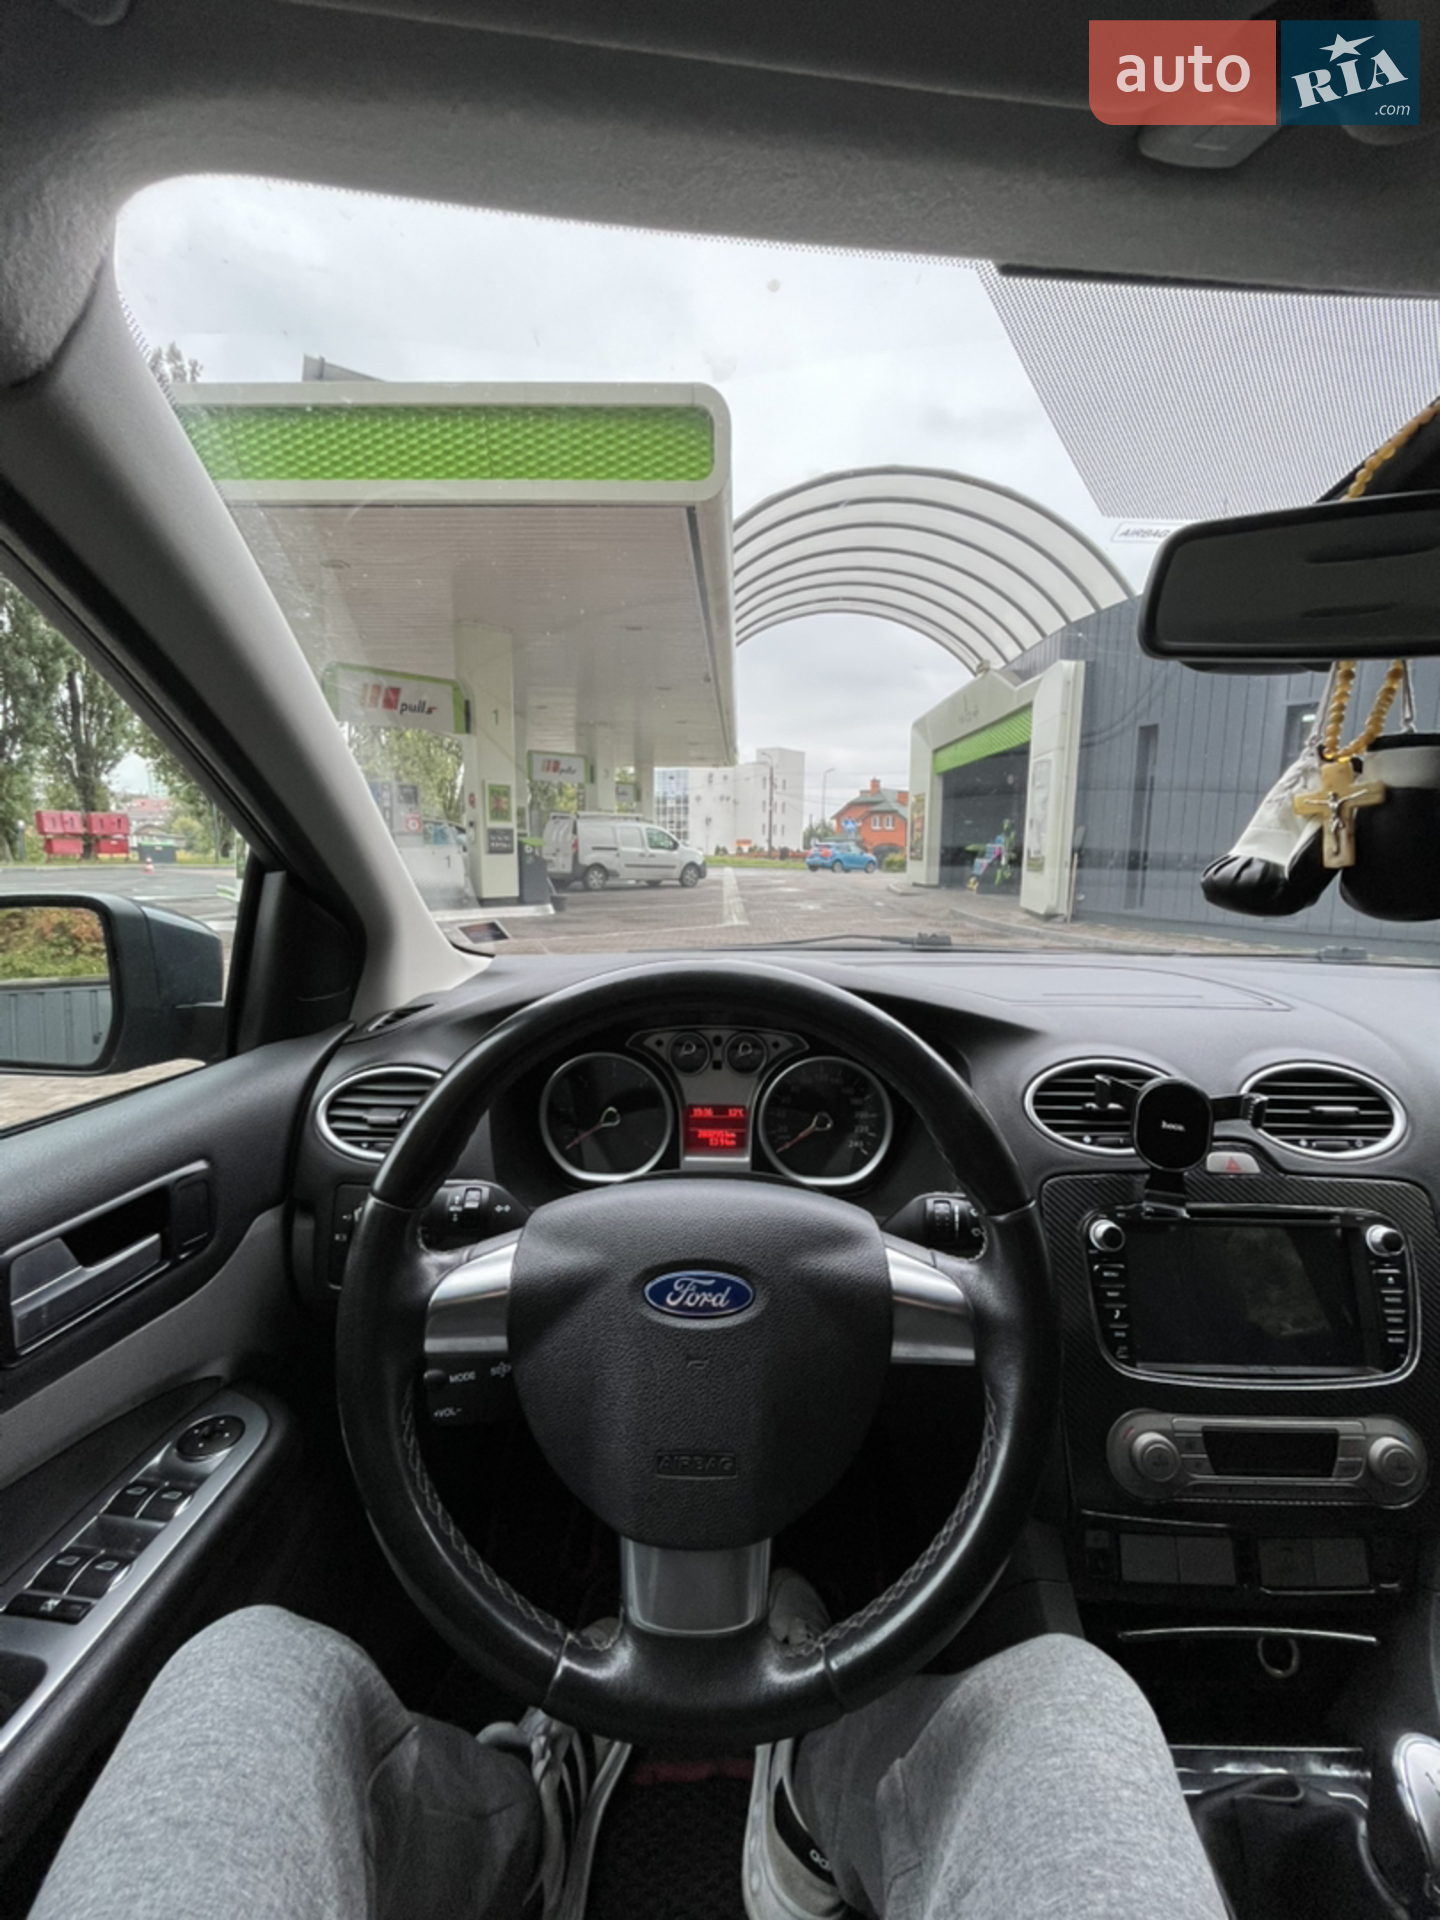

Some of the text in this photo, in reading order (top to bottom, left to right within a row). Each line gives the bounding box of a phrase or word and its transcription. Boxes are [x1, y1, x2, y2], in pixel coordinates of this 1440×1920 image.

[1118, 528, 1170, 538] AIRBAG
[666, 1277, 732, 1307] Ford
[449, 1371, 476, 1384] MODE
[658, 1455, 734, 1471] AIRBAG
